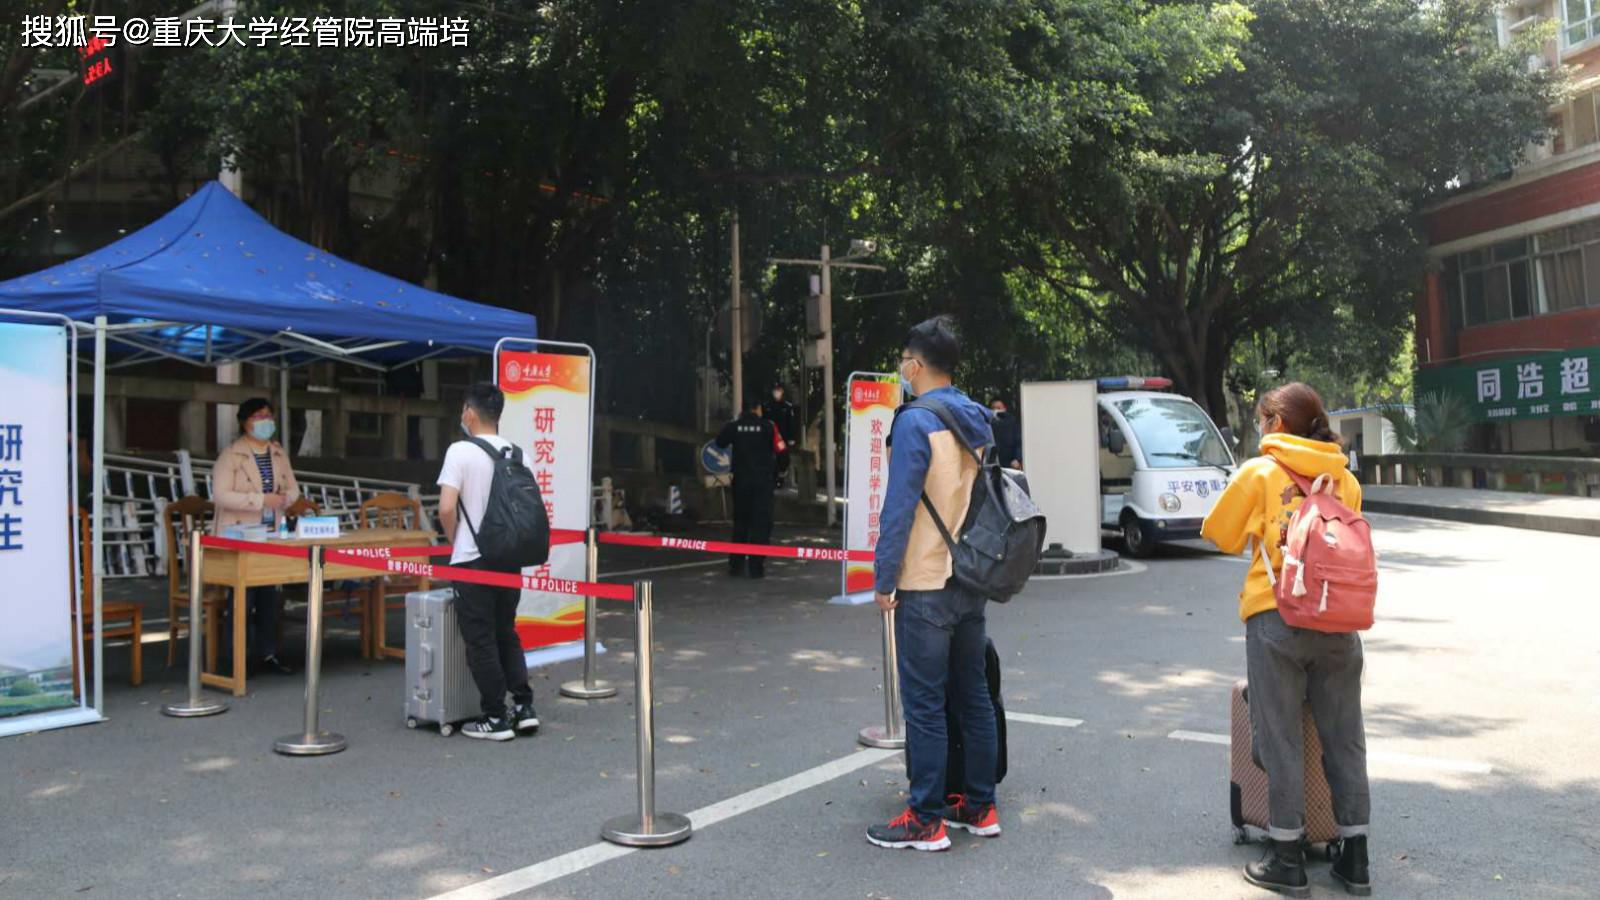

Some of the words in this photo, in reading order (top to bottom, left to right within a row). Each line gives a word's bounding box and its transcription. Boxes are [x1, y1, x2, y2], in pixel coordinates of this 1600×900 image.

[1168, 480, 1194, 493] 平安
[677, 538, 707, 550] POLICE
[815, 550, 849, 560] POLICE
[402, 560, 433, 576] POLICE
[541, 578, 578, 593] POLICE
